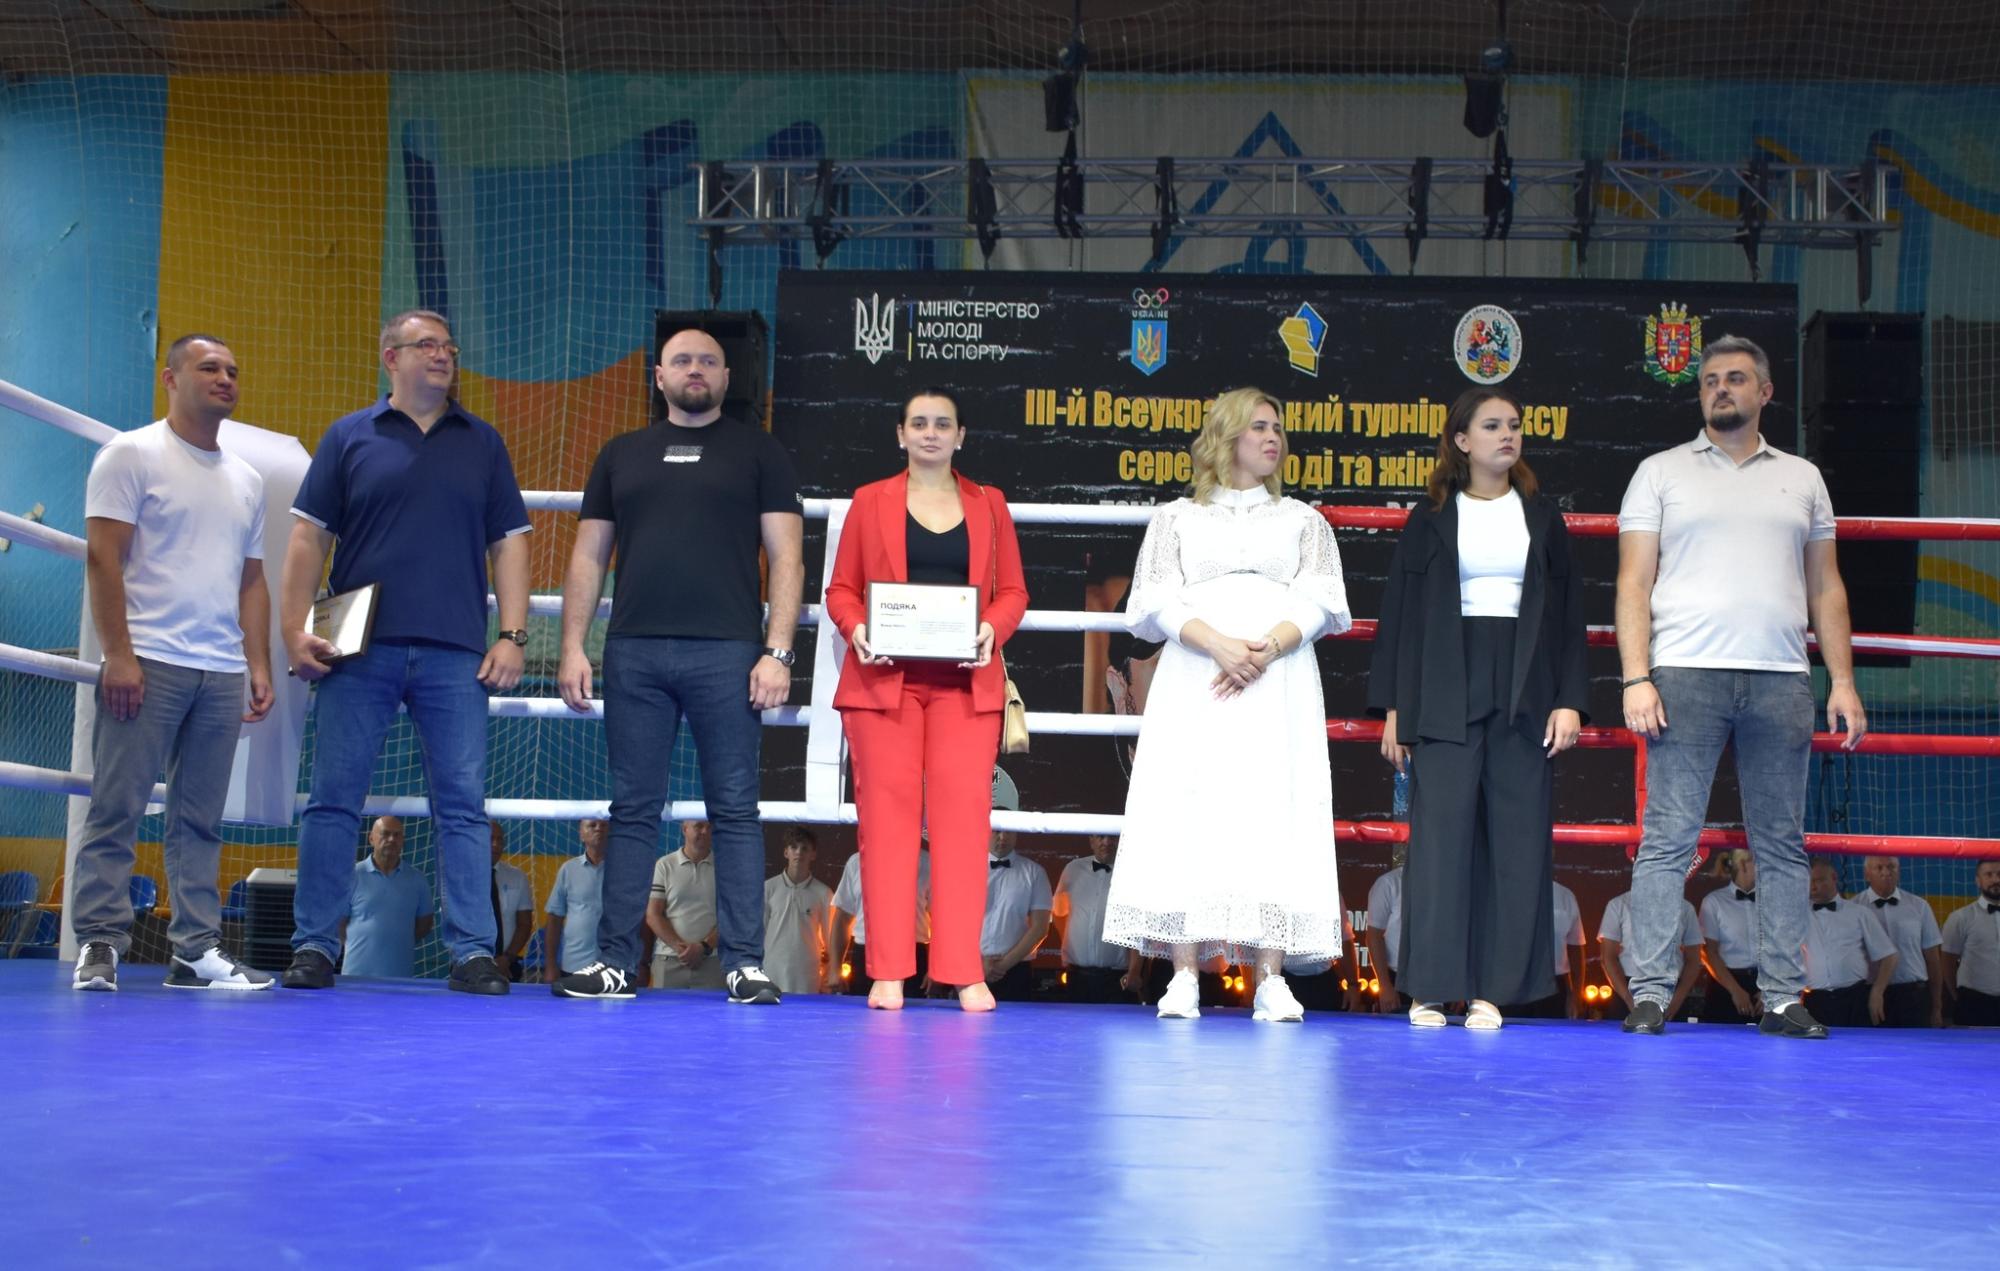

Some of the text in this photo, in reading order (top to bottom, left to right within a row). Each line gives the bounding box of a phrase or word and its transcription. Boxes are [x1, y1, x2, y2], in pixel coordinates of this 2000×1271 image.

[918, 300, 1040, 319] МІНІСТЕРСТВО
[917, 321, 983, 341] МОЛОДІ
[917, 343, 1009, 361] ТА СПОРТУ
[1349, 397, 1447, 438] турнір
[1118, 449, 1199, 486] сере
[1339, 455, 1372, 486] та
[880, 602, 916, 611] ПОДЯКА
